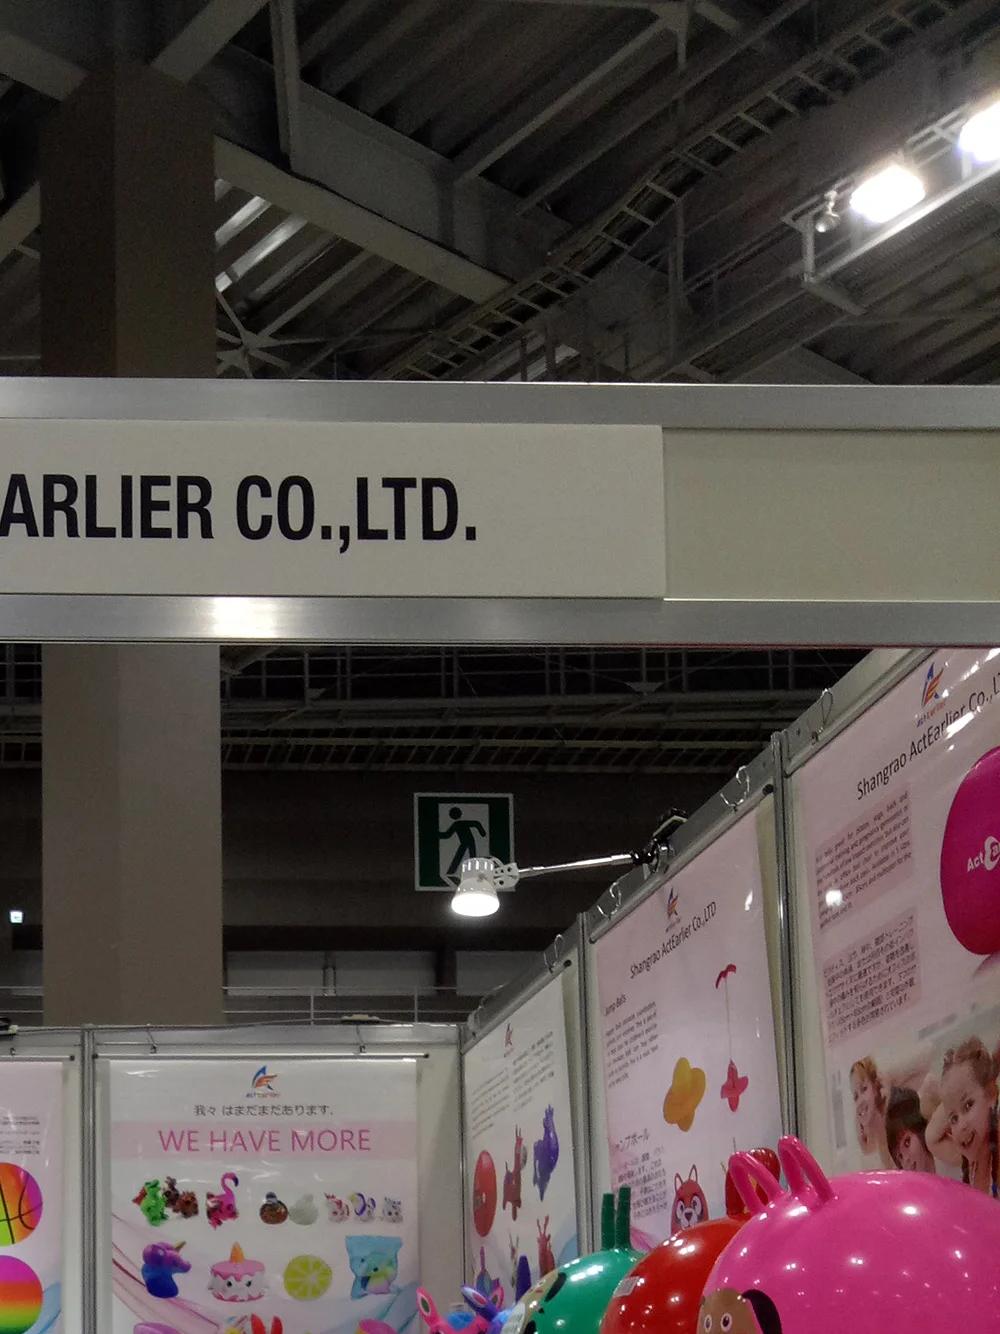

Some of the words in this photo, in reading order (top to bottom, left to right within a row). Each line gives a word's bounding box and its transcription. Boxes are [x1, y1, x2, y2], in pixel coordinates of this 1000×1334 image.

[235, 474, 477, 554] CO.,LTD.
[857, 753, 907, 800] Shangrao
[630, 949, 661, 979] Shangrao
[661, 924, 692, 957] ActEarlier
[158, 1129, 200, 1152] WE
[209, 1129, 281, 1152] HAVE
[291, 1128, 372, 1152] MORE
